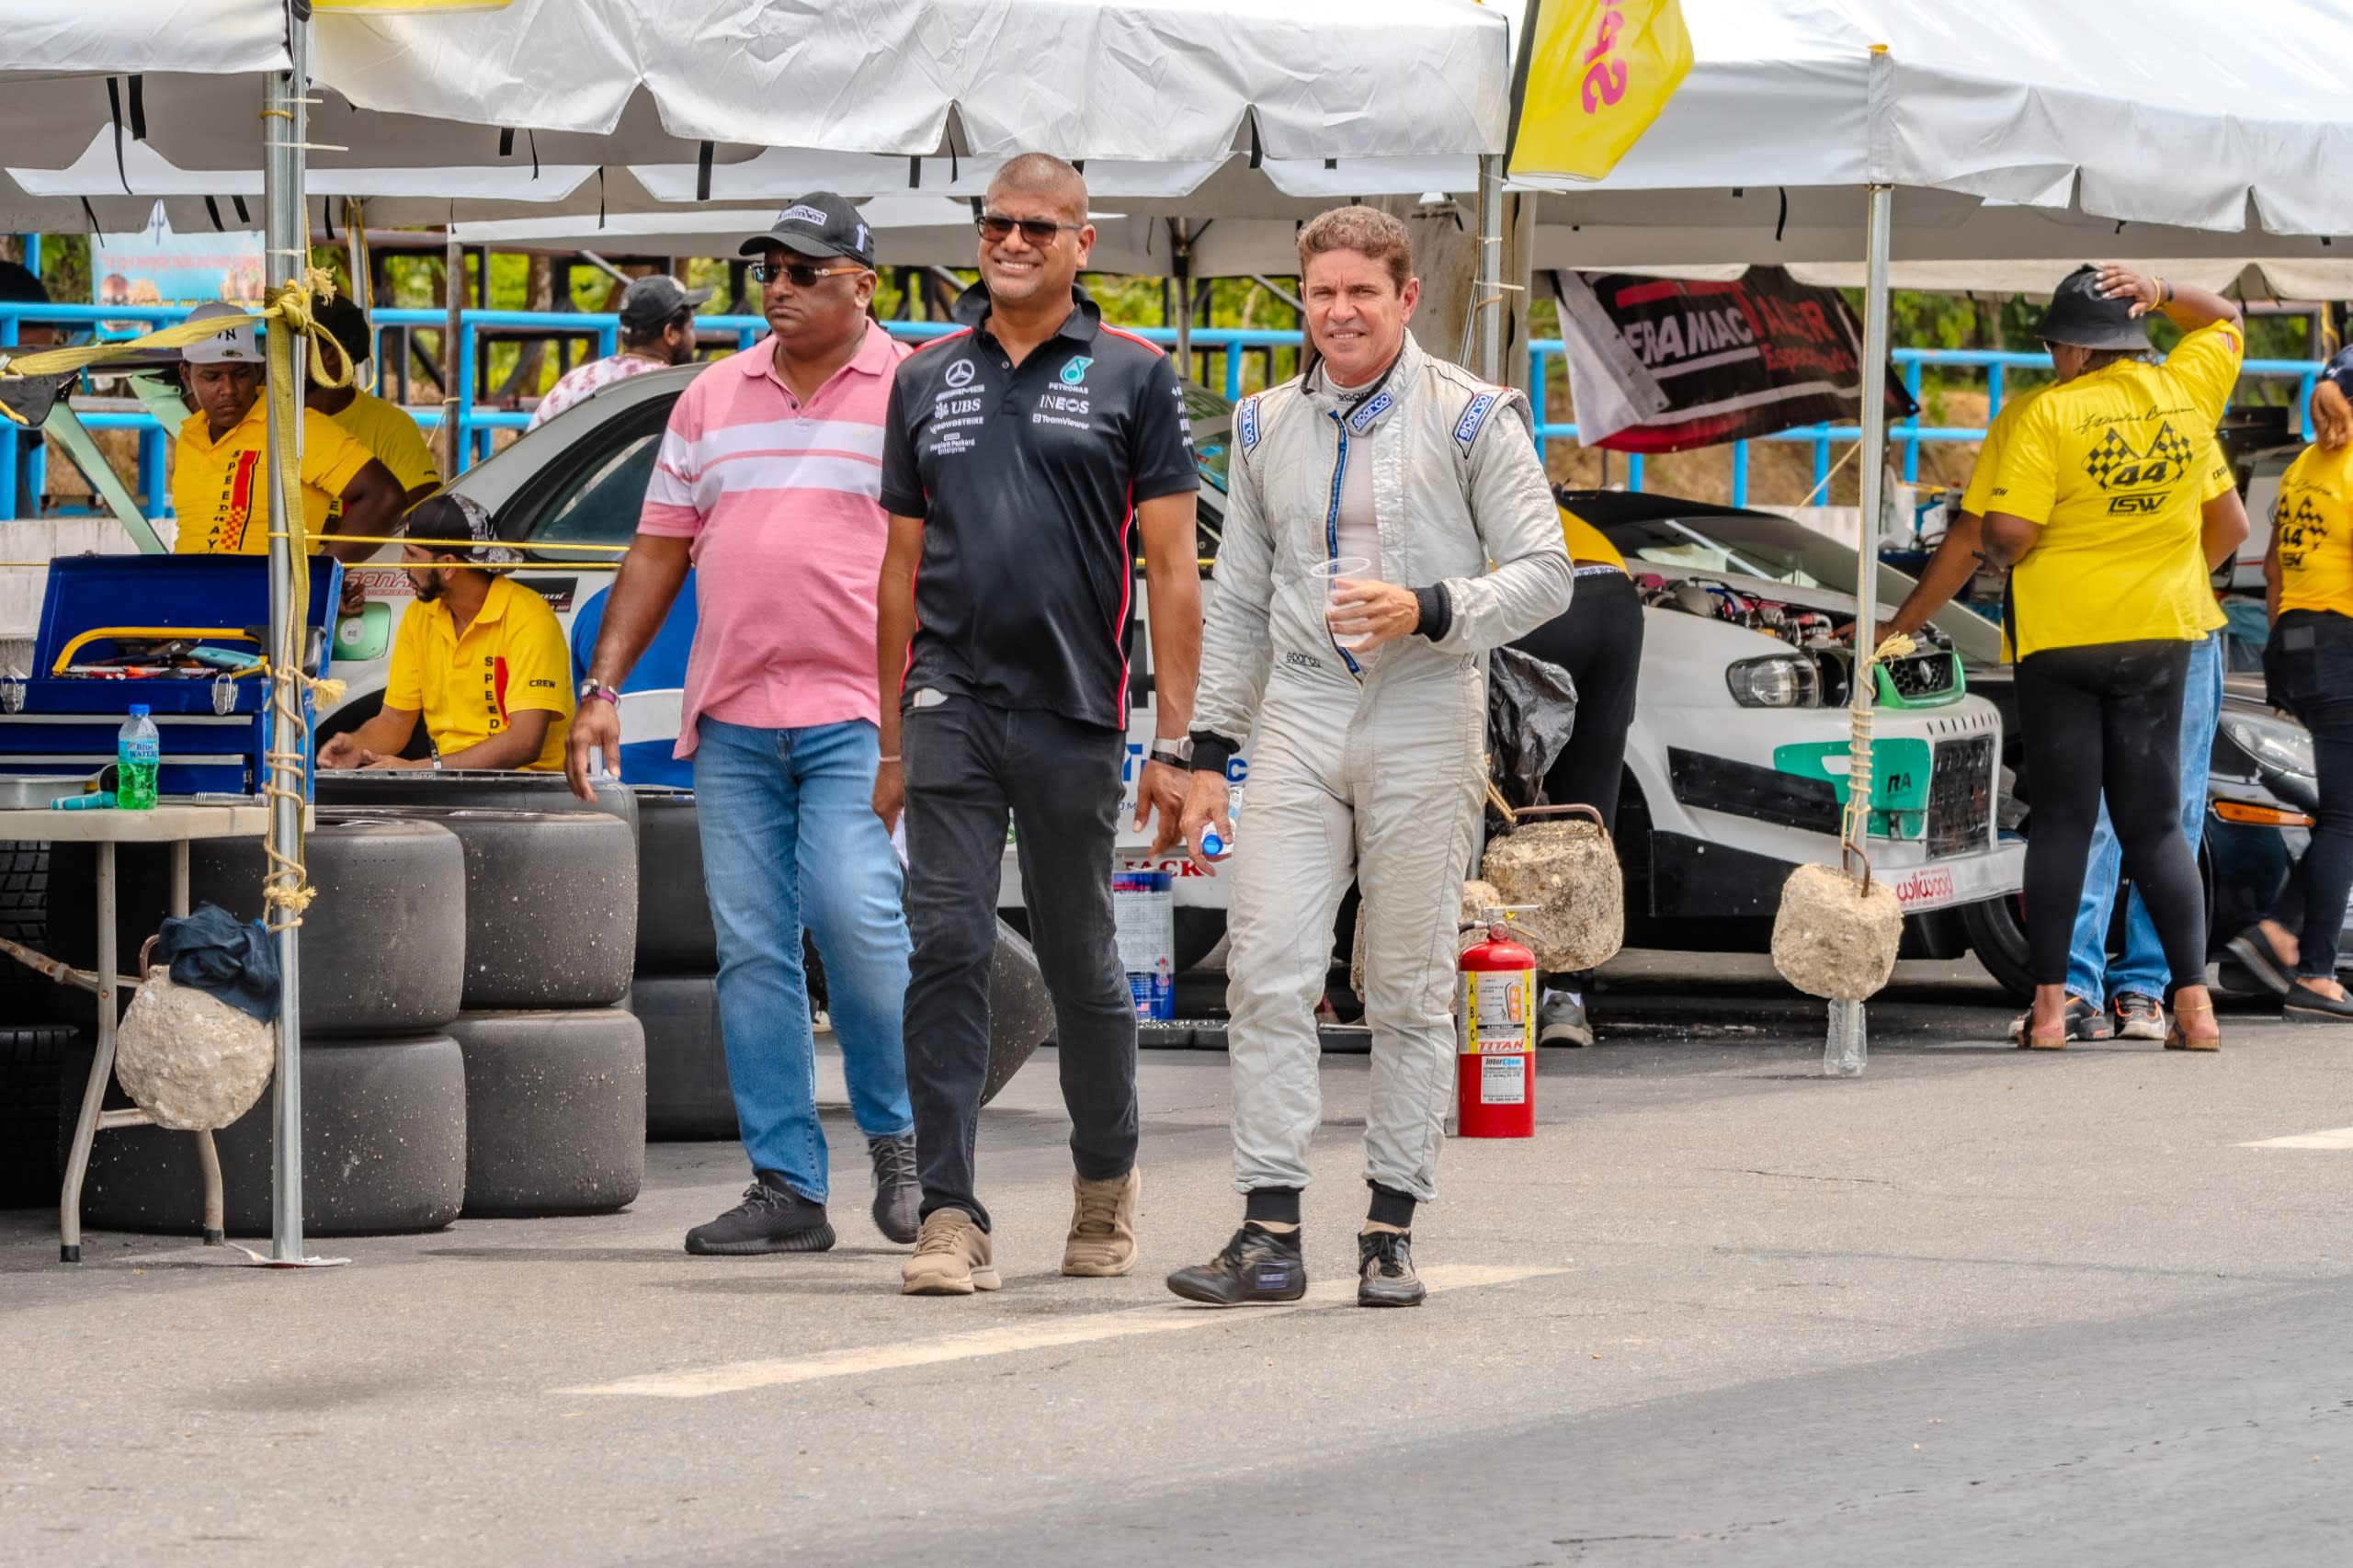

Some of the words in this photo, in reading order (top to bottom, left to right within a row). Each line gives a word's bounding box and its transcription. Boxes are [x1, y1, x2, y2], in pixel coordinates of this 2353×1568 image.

[1049, 381, 1089, 395] PETRONAS
[1040, 394, 1090, 414] INEOS
[1336, 392, 1370, 403] spar
[951, 398, 982, 415] UBS
[1353, 393, 1391, 427] sparco
[932, 416, 984, 432] CROWDSTRIKE
[1041, 415, 1090, 430] TeamViewer
[1457, 394, 1492, 439] sparco
[2112, 461, 2167, 488] 44
[1286, 651, 1323, 668] sparco
[529, 679, 556, 689] CREW
[1478, 1037, 1525, 1051] TITAN
